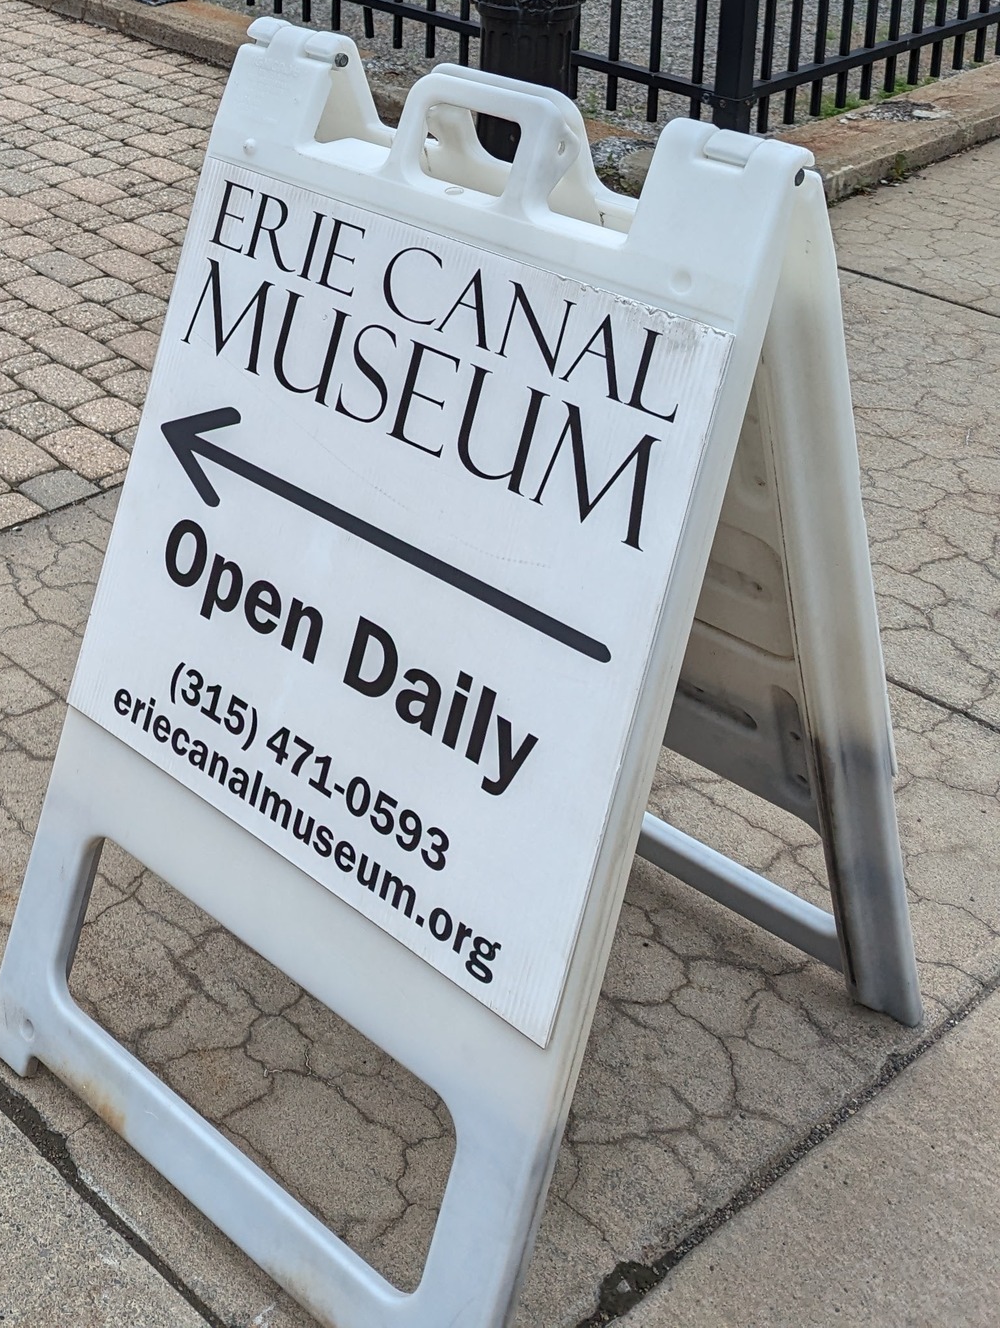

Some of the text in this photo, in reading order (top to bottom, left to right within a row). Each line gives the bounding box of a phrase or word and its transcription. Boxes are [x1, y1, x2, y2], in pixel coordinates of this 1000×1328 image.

[181, 258, 662, 552] MUSEUM
[209, 179, 679, 423] ERIE CANAL
[165, 519, 539, 797] Open Daily
[170, 661, 450, 871] (315) 471-0593
[113, 688, 502, 984] eriecanalmuseum.org
